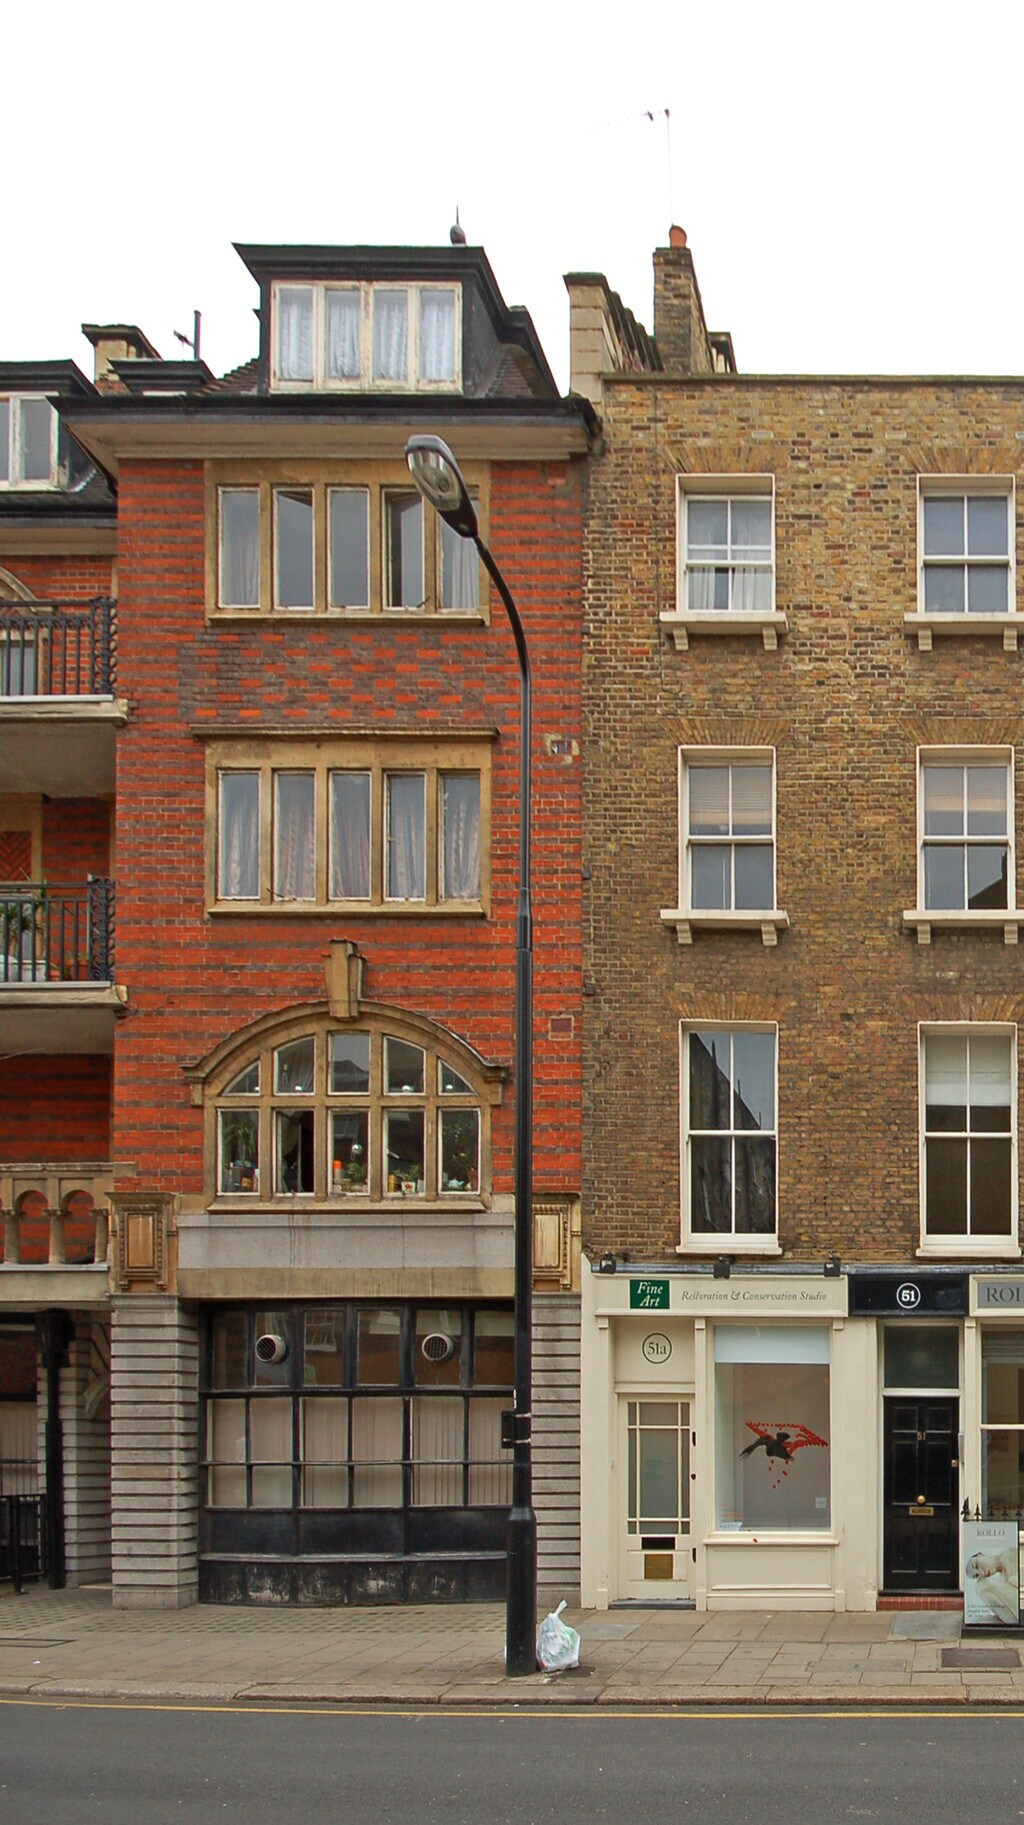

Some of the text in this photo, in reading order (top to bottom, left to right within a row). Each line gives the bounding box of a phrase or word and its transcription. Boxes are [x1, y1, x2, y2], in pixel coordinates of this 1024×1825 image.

[637, 1282, 664, 1295] Fine
[640, 1295, 660, 1307] Art
[681, 1290, 827, 1301] Restoration & Conservation Studio
[901, 1289, 916, 1302] 51
[648, 1341, 667, 1355] 51a
[976, 1529, 1006, 1537] ROLLO
